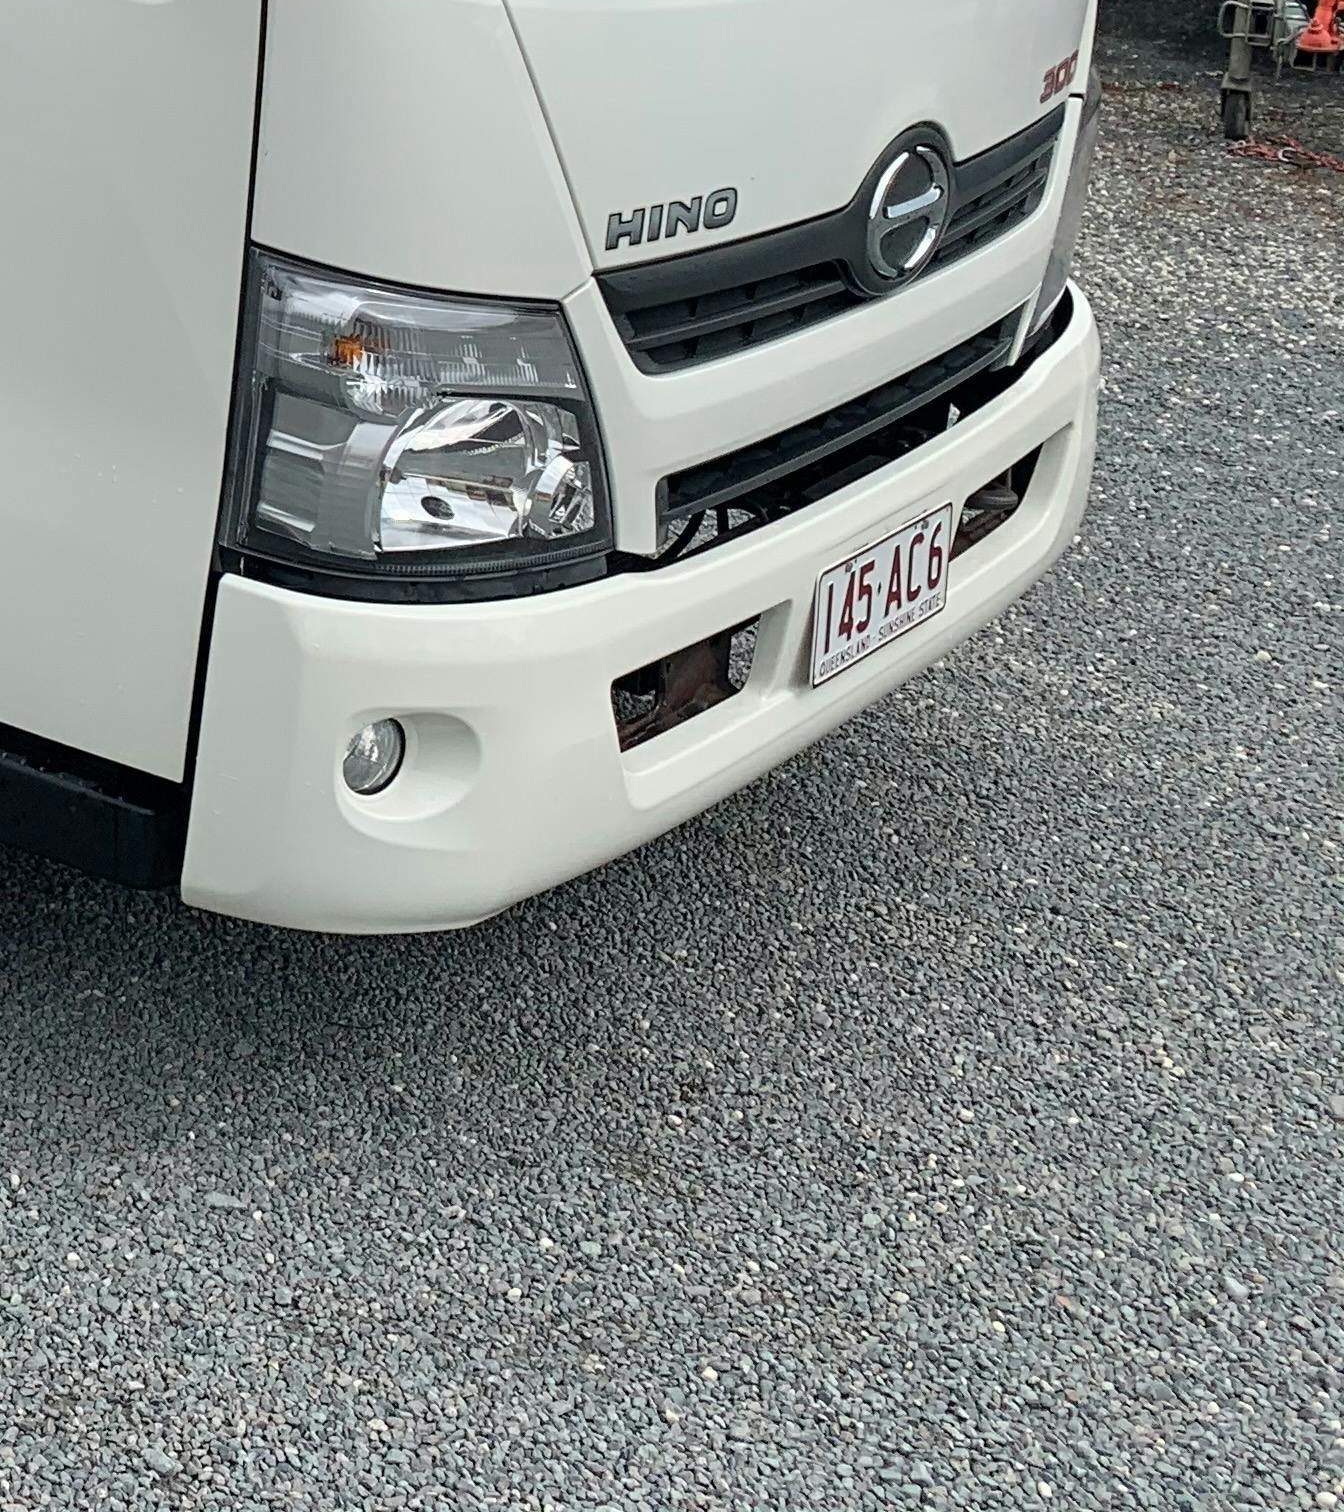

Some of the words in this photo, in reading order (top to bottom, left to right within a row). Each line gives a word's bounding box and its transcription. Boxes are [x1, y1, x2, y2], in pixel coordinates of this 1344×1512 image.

[1039, 49, 1079, 104] 300
[605, 187, 738, 251] HINO
[819, 634, 871, 677] QUEENSLAND
[878, 605, 916, 641] SUNSHINE
[918, 591, 942, 617] STATE
